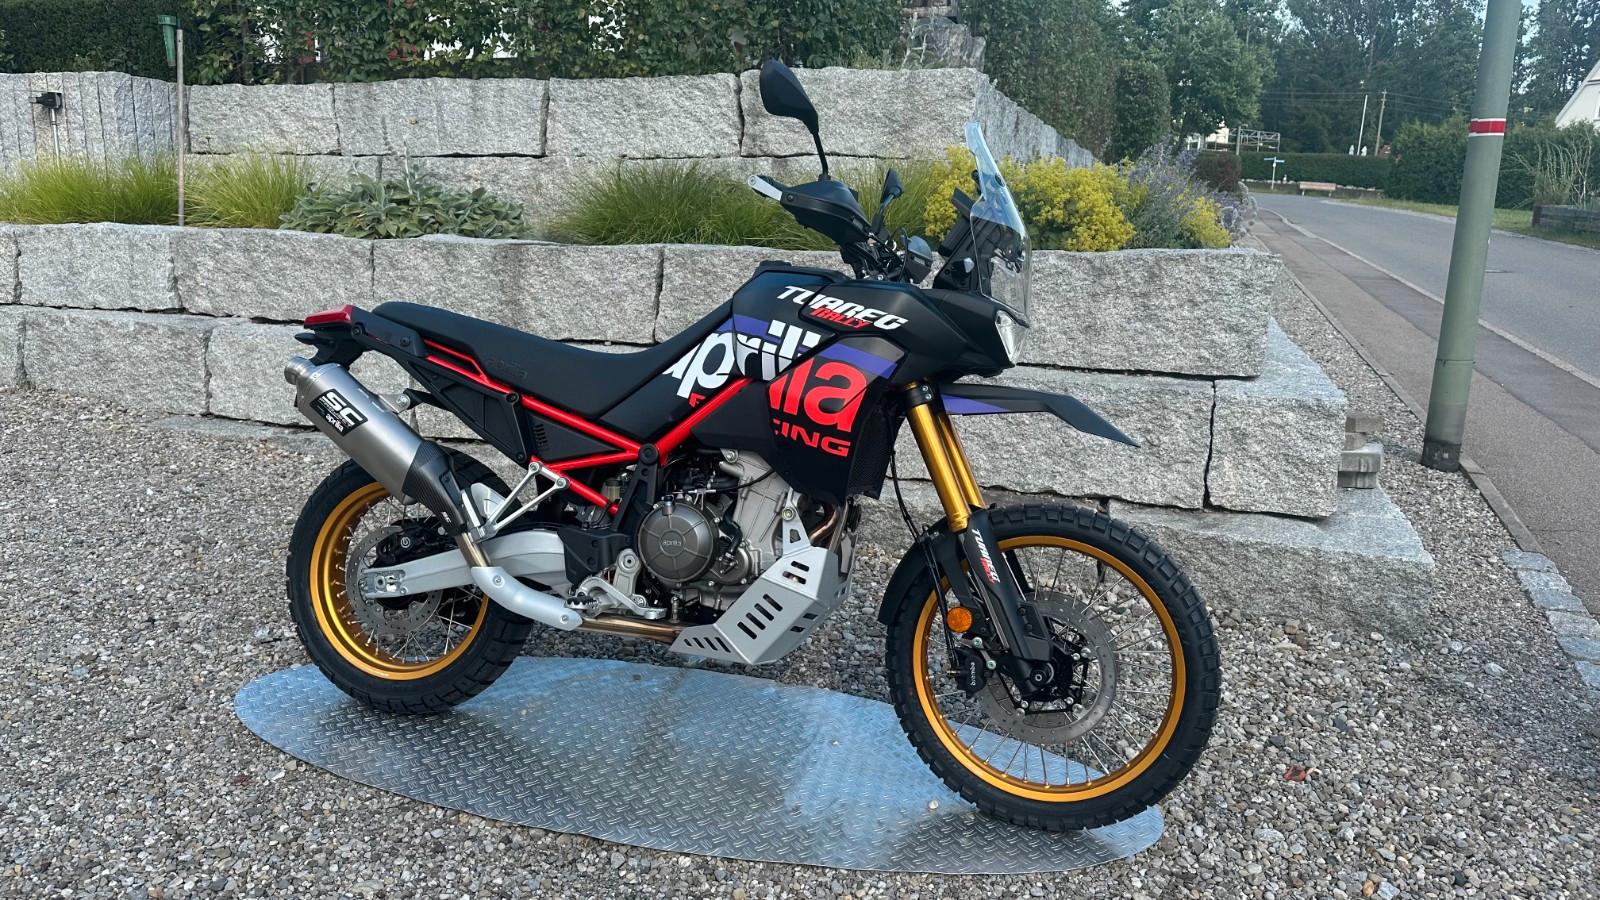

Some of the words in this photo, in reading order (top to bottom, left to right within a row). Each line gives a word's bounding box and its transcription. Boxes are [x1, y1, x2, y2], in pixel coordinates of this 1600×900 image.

[777, 285, 909, 330] TUAREG
[810, 306, 871, 328] RALLY
[321, 391, 364, 426] SC
